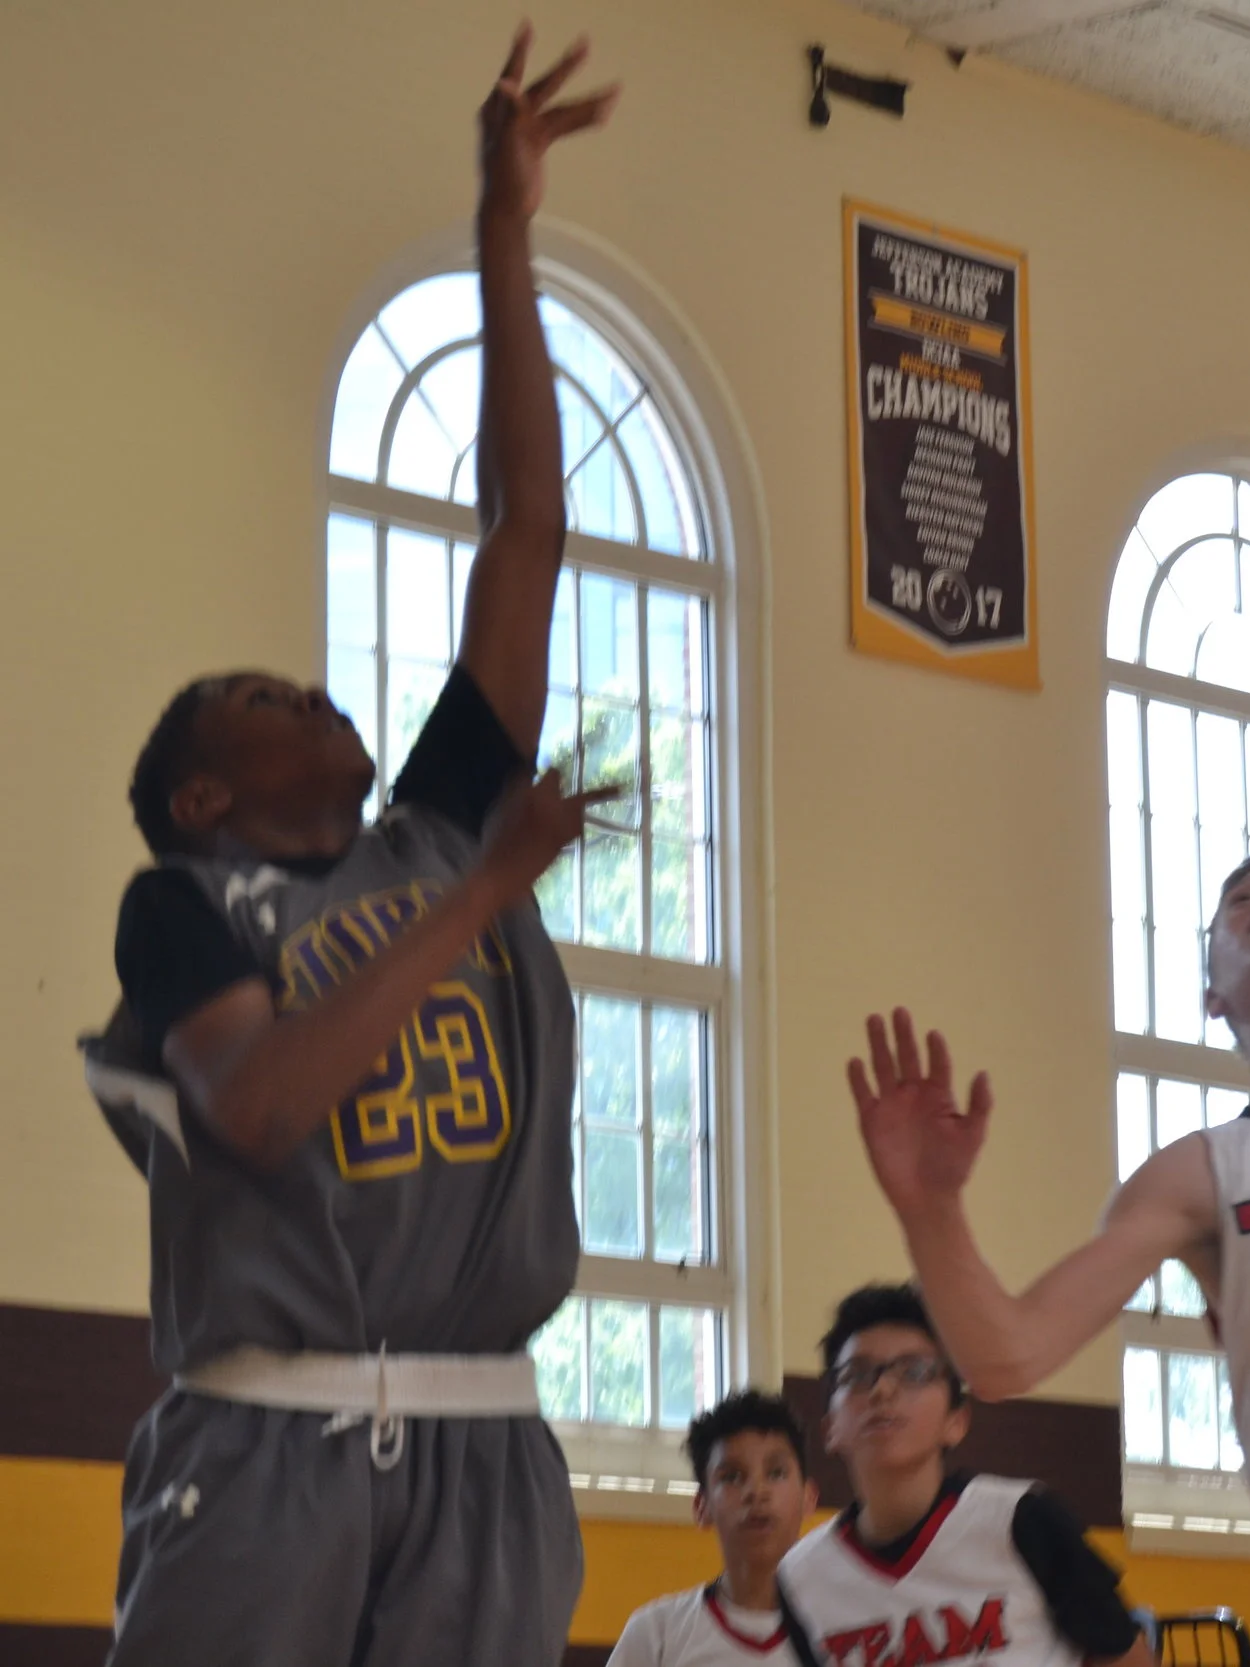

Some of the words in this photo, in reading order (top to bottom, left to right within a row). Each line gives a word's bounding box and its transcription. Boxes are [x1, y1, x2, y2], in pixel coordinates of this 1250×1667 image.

[890, 261, 988, 320] TROJANS
[867, 363, 1011, 458] CHAMPIONS
[975, 586, 1003, 629] 17
[329, 980, 512, 1182] 23
